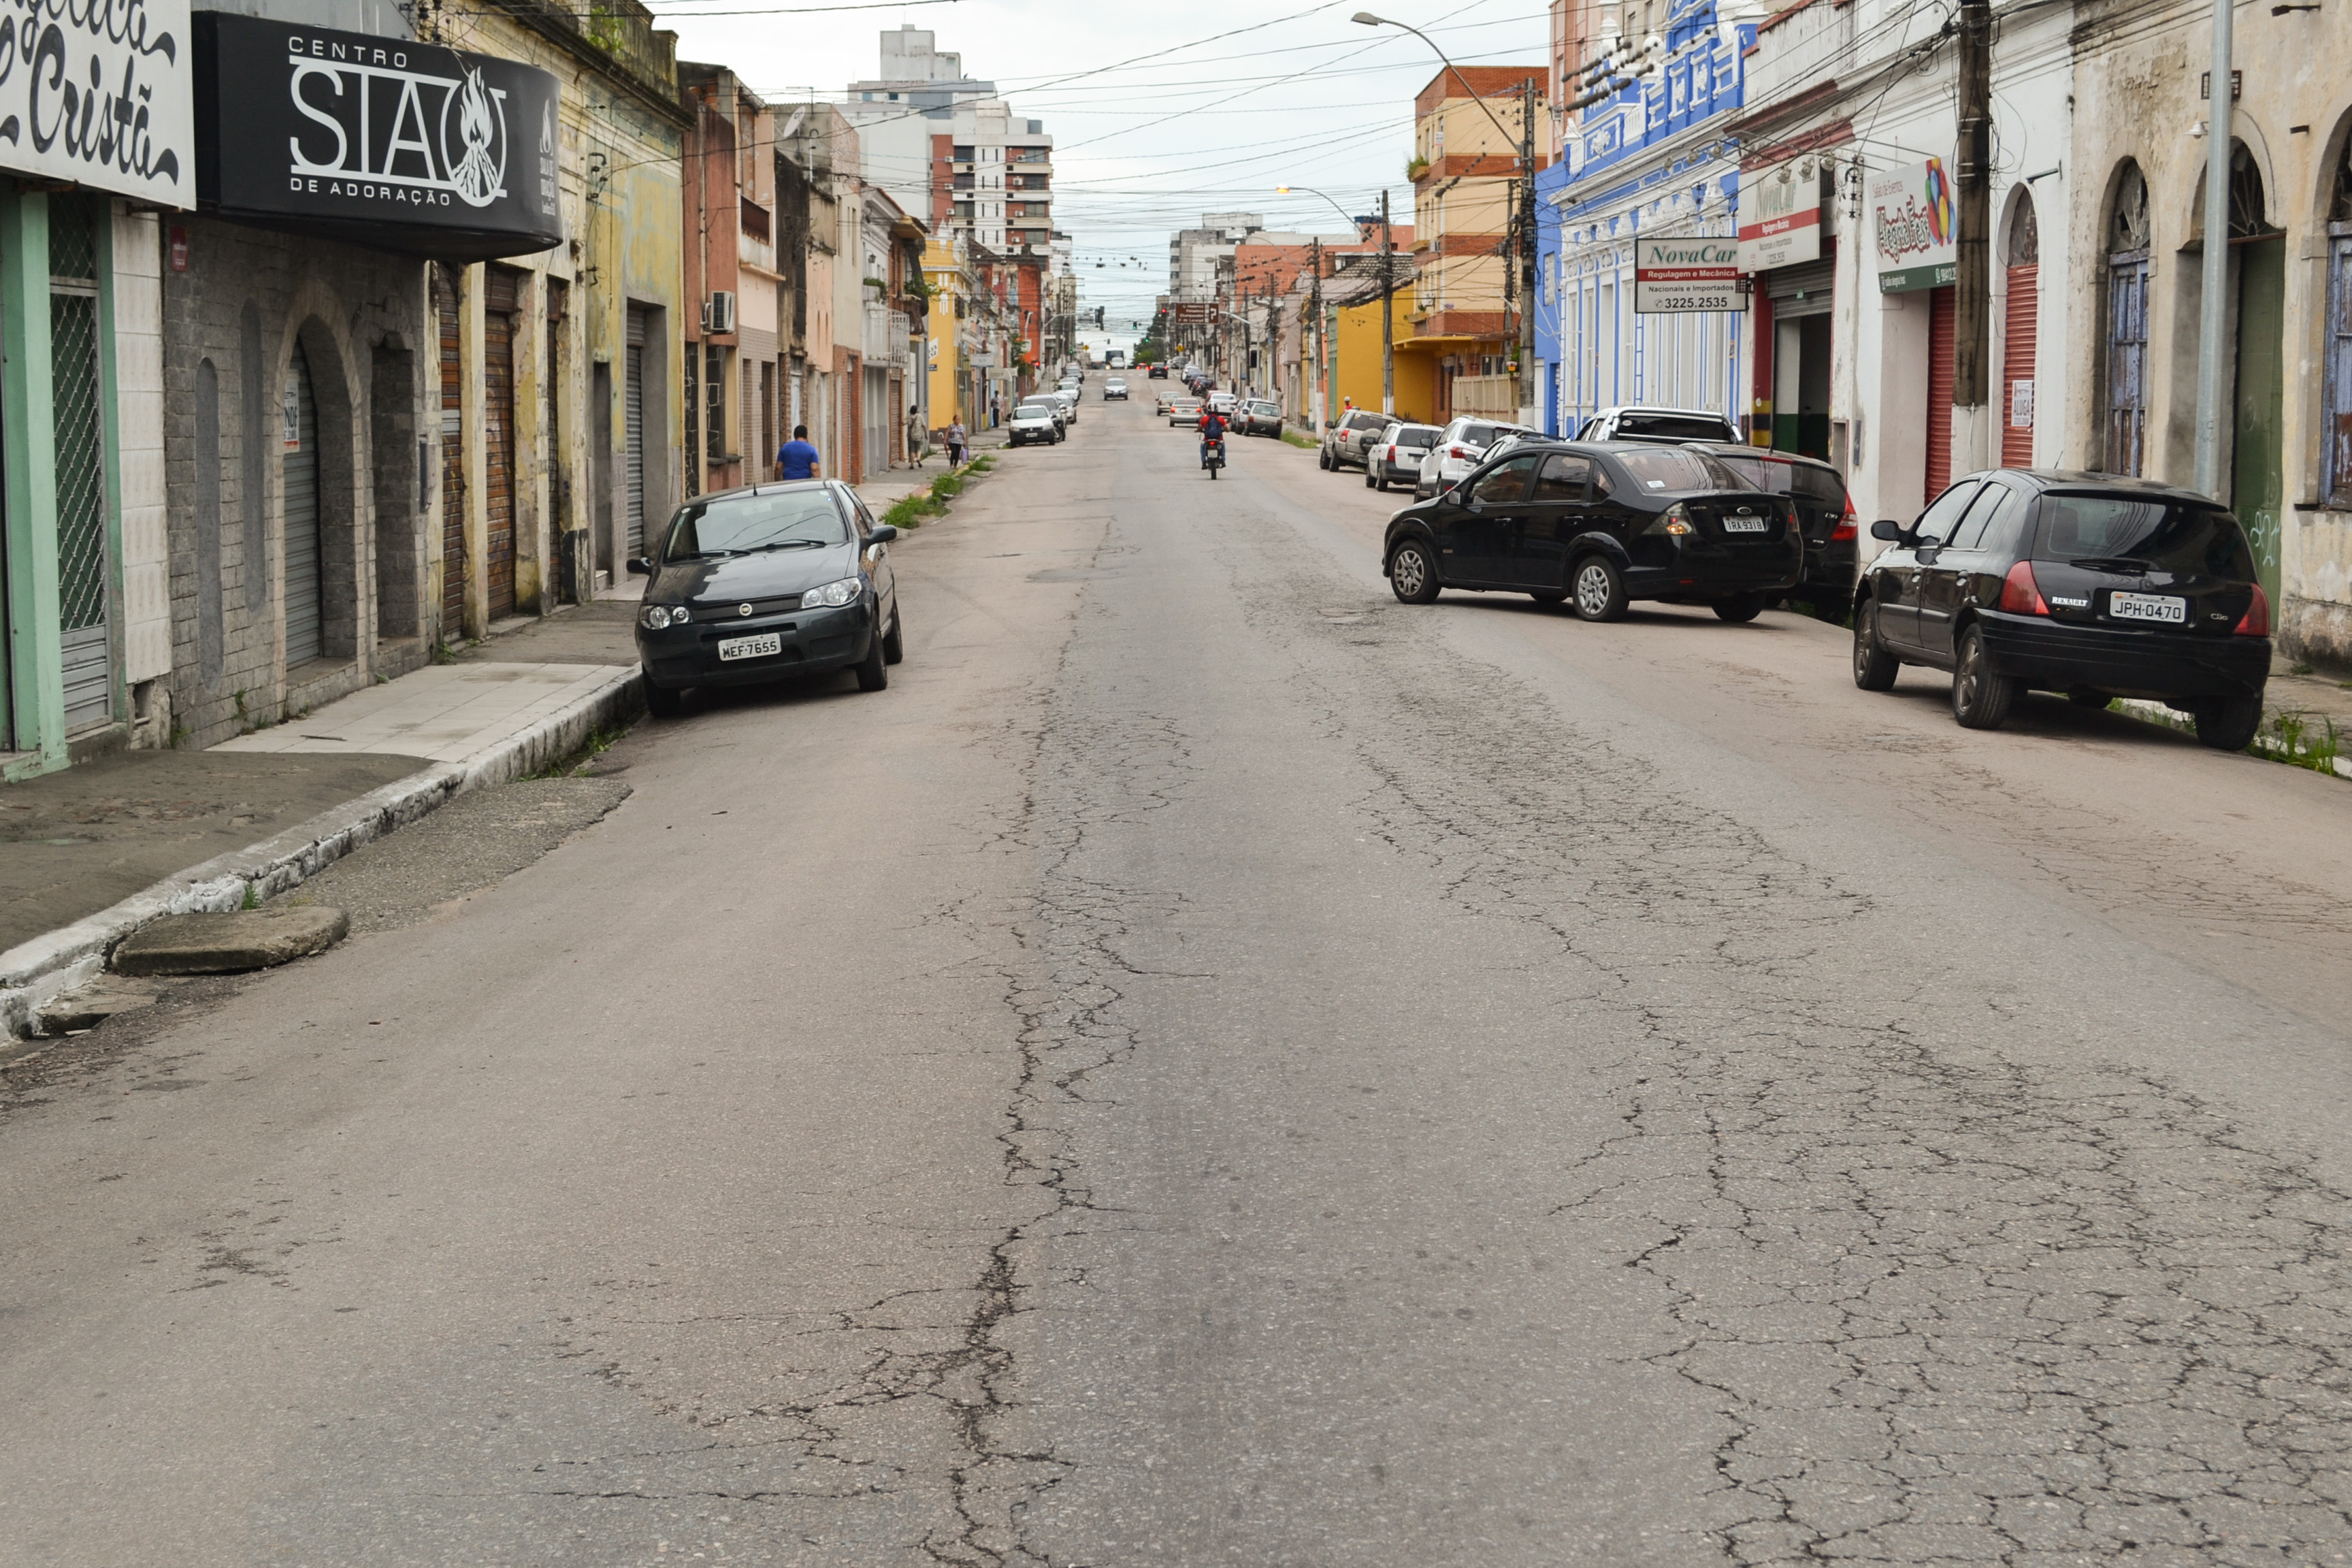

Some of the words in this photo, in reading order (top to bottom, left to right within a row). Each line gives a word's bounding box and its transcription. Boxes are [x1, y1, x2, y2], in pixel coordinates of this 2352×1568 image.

[289, 37, 407, 68] CENTRO
[30, 24, 178, 185] Cristã
[291, 178, 318, 193] DE
[330, 182, 450, 206] ADORAÇÃO
[1647, 244, 1737, 265] NovaCar
[1648, 271, 1691, 280] Regulagem
[1665, 297, 1728, 308] 3225.2535
[2052, 596, 2088, 606] RENAULT
